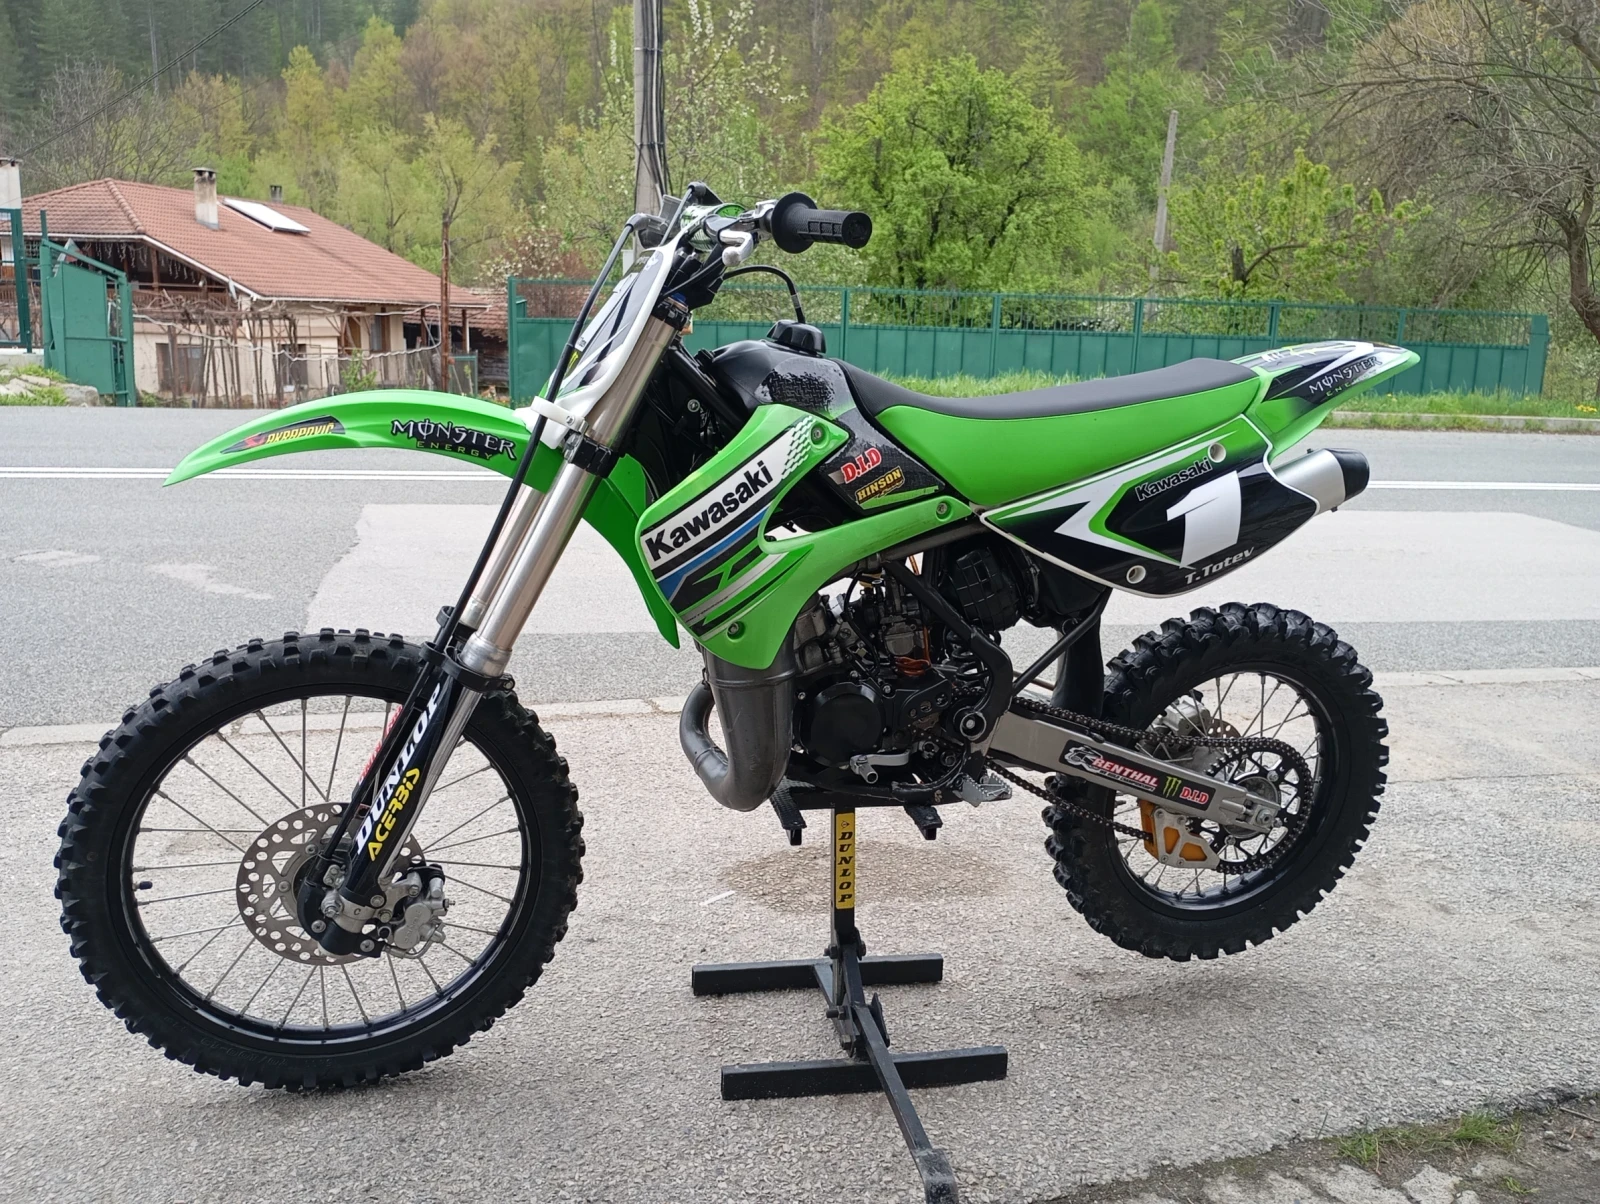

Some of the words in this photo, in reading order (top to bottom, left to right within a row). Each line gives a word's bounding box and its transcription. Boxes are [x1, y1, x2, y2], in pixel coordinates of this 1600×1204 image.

[1309, 355, 1383, 394] MONSTER
[391, 418, 516, 460] MONSTER
[417, 440, 493, 460] ENERGY
[841, 447, 882, 484] D.I.D
[856, 468, 902, 501] HINSON
[1135, 457, 1213, 501] Kawasaki
[645, 460, 773, 562] Kawasaki
[1166, 470, 1241, 569] 1
[355, 682, 441, 855] DUNLOP
[1091, 757, 1158, 787] RENTHAL
[1179, 786, 1209, 804] D.I.D
[838, 831, 853, 903] DUNLOP
